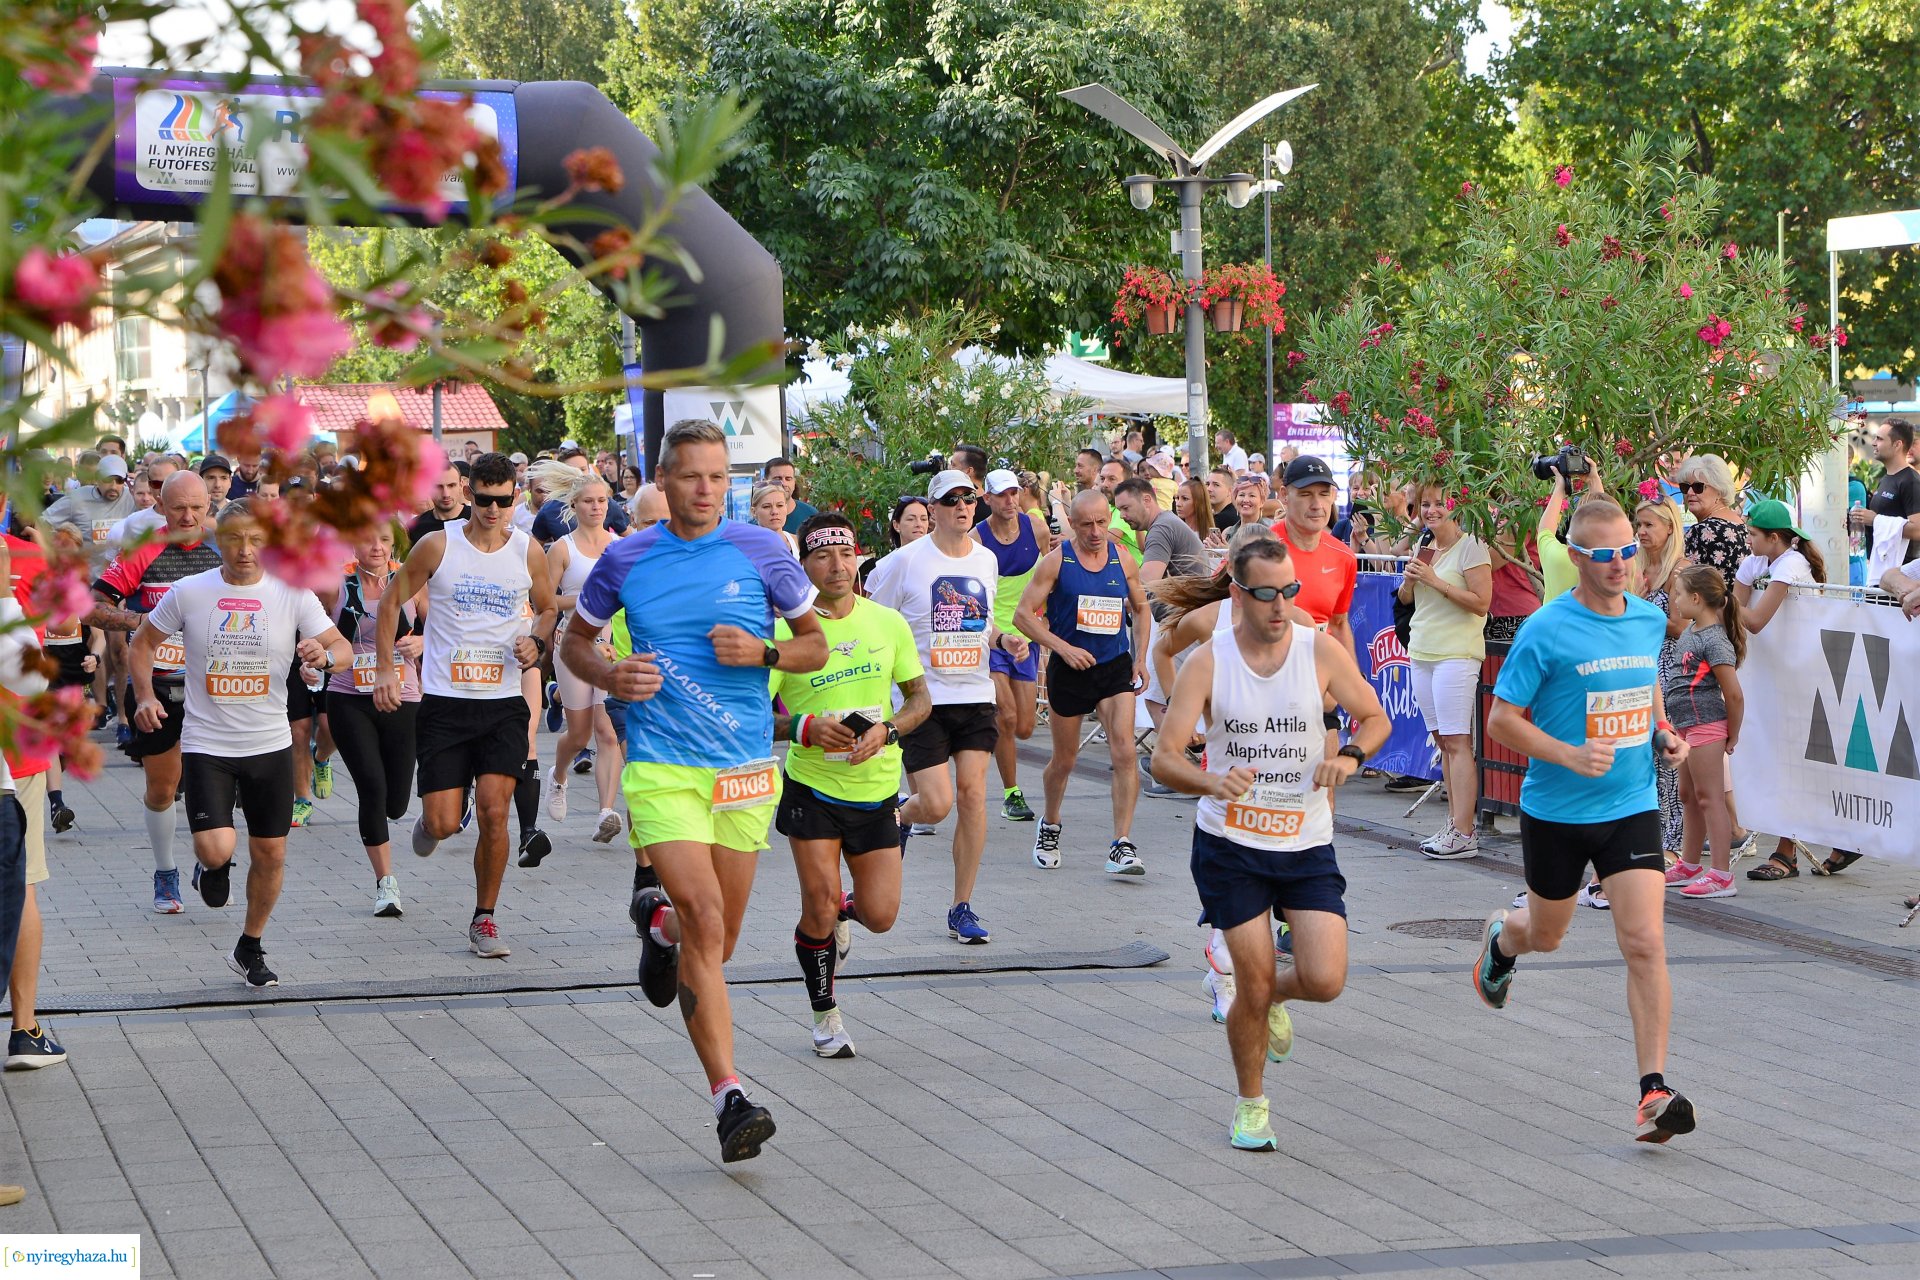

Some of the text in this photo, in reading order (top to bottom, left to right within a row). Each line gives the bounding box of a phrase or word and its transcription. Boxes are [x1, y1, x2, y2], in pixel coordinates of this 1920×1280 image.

[148, 143, 257, 161] II. NYÍREGHÁZI
[148, 157, 256, 174] FUTÓFESZVÁL
[184, 177, 213, 187] sematic
[1297, 428, 1305, 436] IS
[458, 586, 515, 598] INTERSPORT
[934, 610, 964, 618] KOLOR
[1082, 611, 1119, 626] 10089
[934, 623, 961, 631] NIGHT
[155, 645, 186, 663] 001
[935, 650, 978, 666] 10028
[455, 665, 500, 681] 10043
[810, 662, 871, 688] Gepard
[210, 677, 265, 694] 10006
[719, 711, 741, 733] SE
[1224, 716, 1307, 733] Kiss Attila
[1594, 711, 1648, 736] 10144
[1225, 742, 1307, 763] Alapítvány
[1229, 766, 1302, 784] erencs
[720, 772, 770, 800] 10108
[1832, 790, 1893, 829] WITTUR
[1233, 807, 1299, 834] 10058
[814, 949, 830, 997] kalenji
